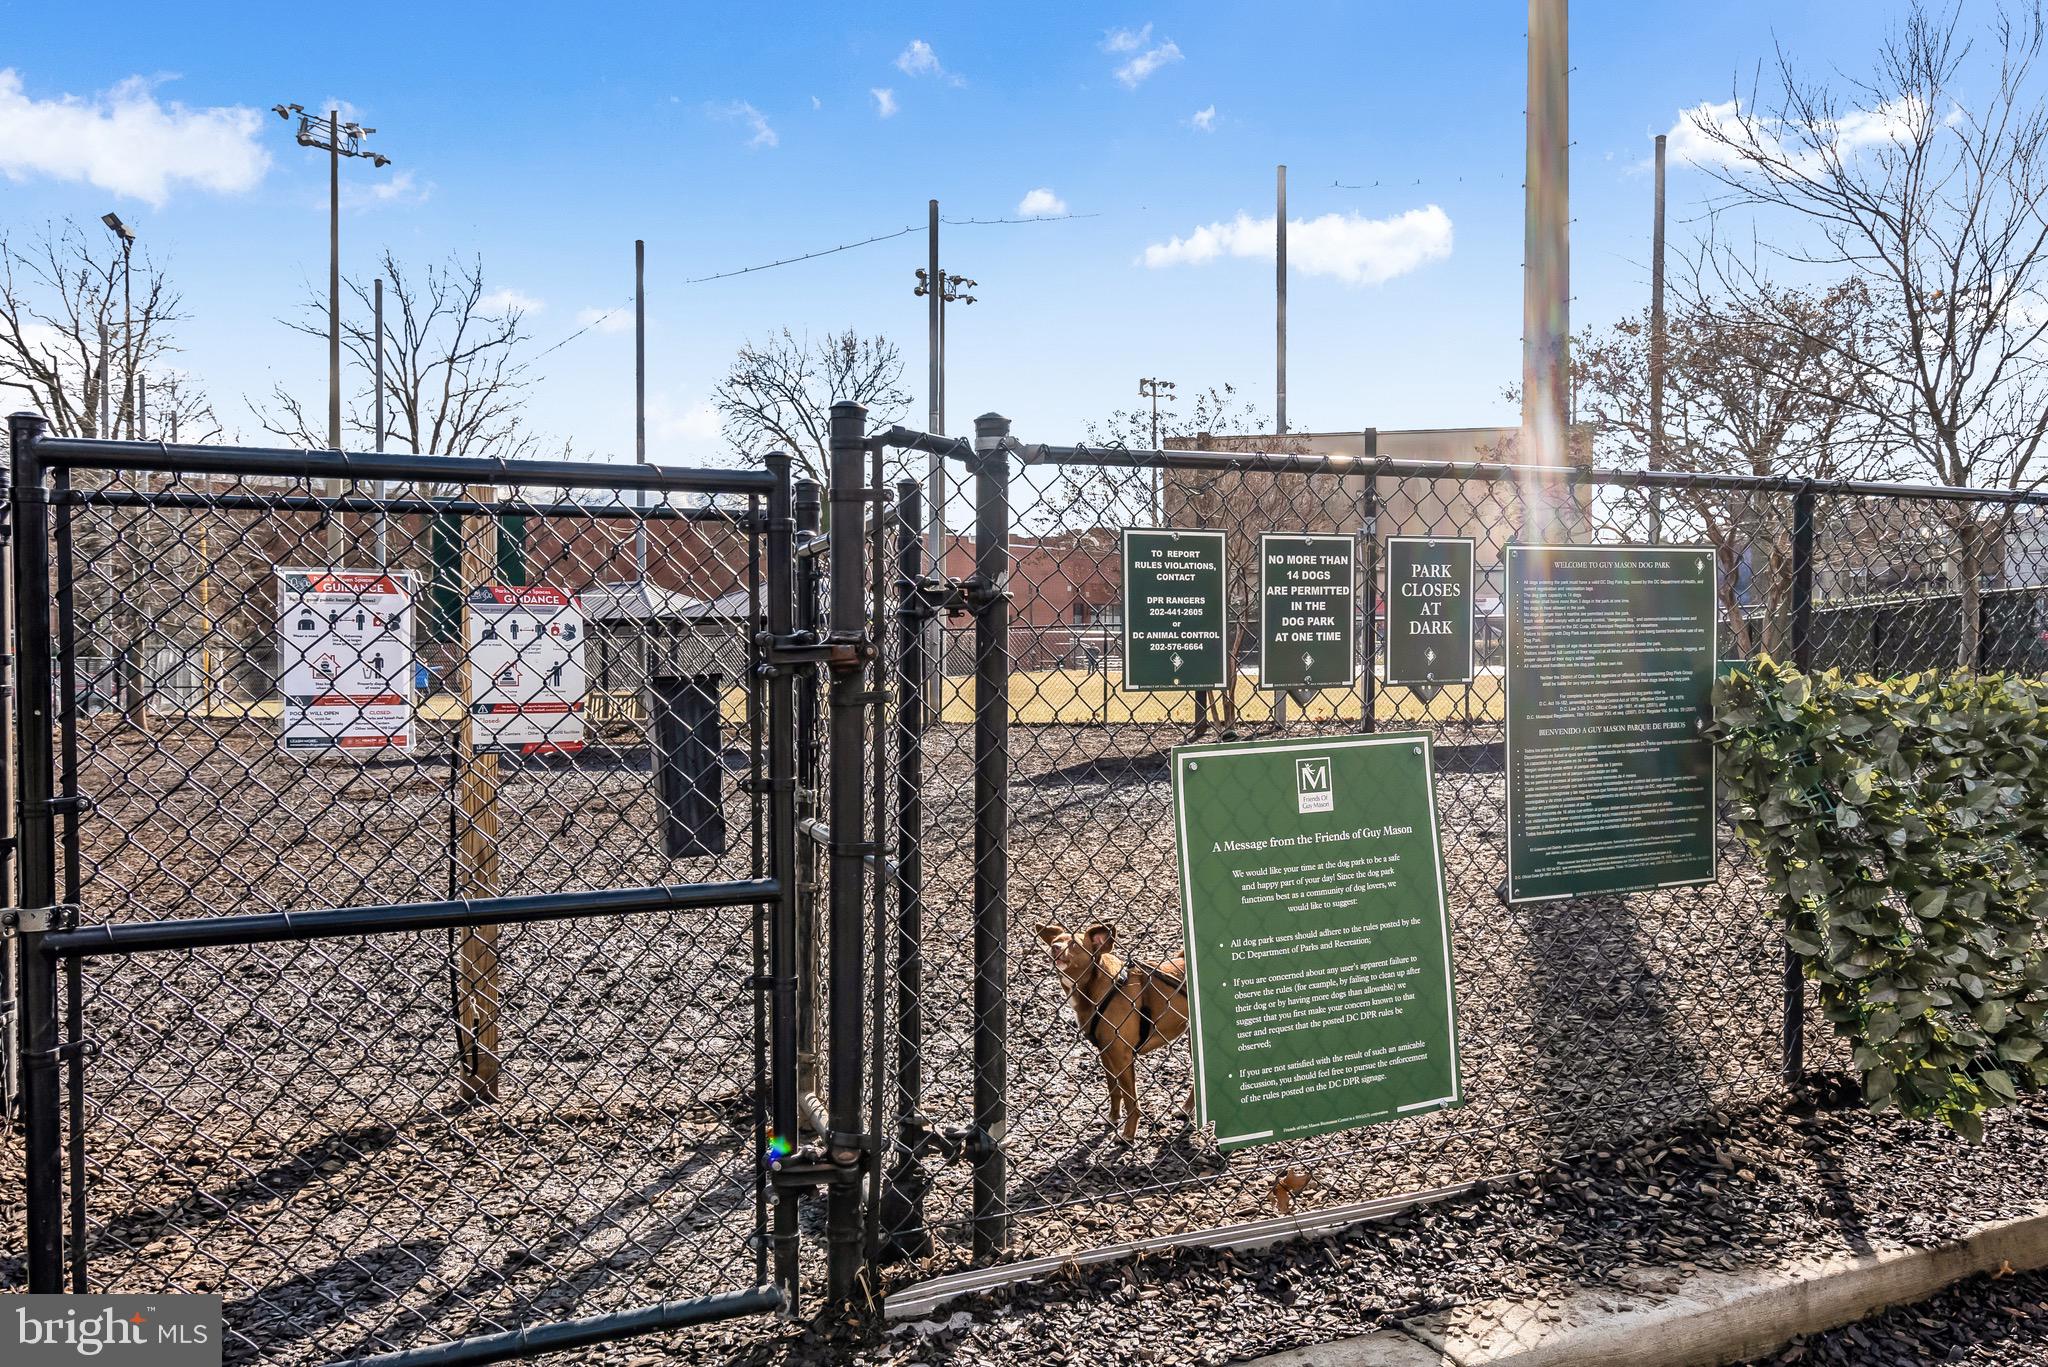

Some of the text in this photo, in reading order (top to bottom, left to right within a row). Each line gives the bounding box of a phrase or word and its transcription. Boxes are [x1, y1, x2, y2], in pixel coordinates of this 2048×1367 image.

[1167, 550, 1200, 558] REPORT
[1268, 555, 1348, 564] NO MORE THAN
[1165, 562, 1216, 571] VIOLATIONS,
[1411, 564, 1452, 578] PARK
[1287, 571, 1331, 580] 14 DOGS
[1267, 586, 1350, 595] ARE PERMITTED
[1402, 583, 1460, 597] CLOSES
[1150, 608, 1203, 616] 202-441-2605
[1291, 602, 1326, 610] IN THE
[1420, 602, 1442, 616] AT
[1282, 617, 1335, 626] DOG PARK
[1409, 621, 1453, 635] DARK
[1275, 632, 1341, 642] AT ONE TIME
[1539, 728, 1581, 736] BIENVENIDO
[1588, 726, 1603, 734] GUY
[1603, 724, 1626, 732] MASON
[1627, 723, 1651, 732] PARQUE
[1212, 825, 1412, 852] A Message from the Friends of Guy Mason
[1232, 870, 1244, 878] We
[1245, 867, 1268, 876] would
[1269, 866, 1282, 874] like
[1283, 866, 1299, 874] your
[1325, 861, 1336, 869] the
[1336, 859, 1350, 868] dog
[1350, 857, 1365, 867] park
[1388, 853, 1400, 861] safe
[1241, 867, 1394, 890] and happy part of your day! Since the dog park
[1241, 894, 1274, 904] functions
[1275, 892, 1290, 900] best
[1306, 887, 1344, 897] community
[1345, 884, 1352, 892] of
[1353, 883, 1366, 892] dog
[1366, 882, 1387, 890] lovers,
[1287, 902, 1309, 911] would
[1310, 901, 1322, 909] like
[1332, 899, 1357, 908] suggest:
[1230, 939, 1241, 947] All
[1242, 938, 1257, 947] dog
[1258, 935, 1274, 946] park
[1294, 929, 1317, 939] should
[1319, 928, 1341, 937] adhere
[1351, 925, 1362, 933] the
[1363, 923, 1379, 931] rules
[1379, 919, 1400, 930] posted
[1401, 919, 1409, 927] by
[1410, 917, 1420, 925] the
[1231, 936, 1371, 960] DC Department of Parks and Recreation;
[1233, 977, 1240, 986] If
[1240, 978, 1254, 987] you
[1268, 969, 1304, 982] concerned
[1305, 969, 1325, 977] about
[1340, 962, 1359, 972] user's
[1360, 960, 1388, 970] apparent
[1389, 956, 1409, 965] failure
[1237, 1039, 1271, 1051] observed;
[1239, 1079, 1278, 1090] discussion,
[1279, 1076, 1292, 1086] you
[1293, 1070, 1316, 1082] should
[1317, 1068, 1330, 1078] feel
[1331, 1067, 1344, 1075] free
[1353, 1062, 1376, 1073] pursue
[1377, 1059, 1388, 1067] the
[1388, 1053, 1427, 1065] enforcement
[1240, 1094, 1249, 1103] of
[1249, 1094, 1261, 1102] the
[1262, 1091, 1280, 1100] rules
[1281, 1085, 1304, 1099] posted
[1316, 1082, 1327, 1091] the
[1328, 1079, 1341, 1089] DC
[1342, 1076, 1360, 1086] DPR
[1361, 1074, 1386, 1084] signage.
